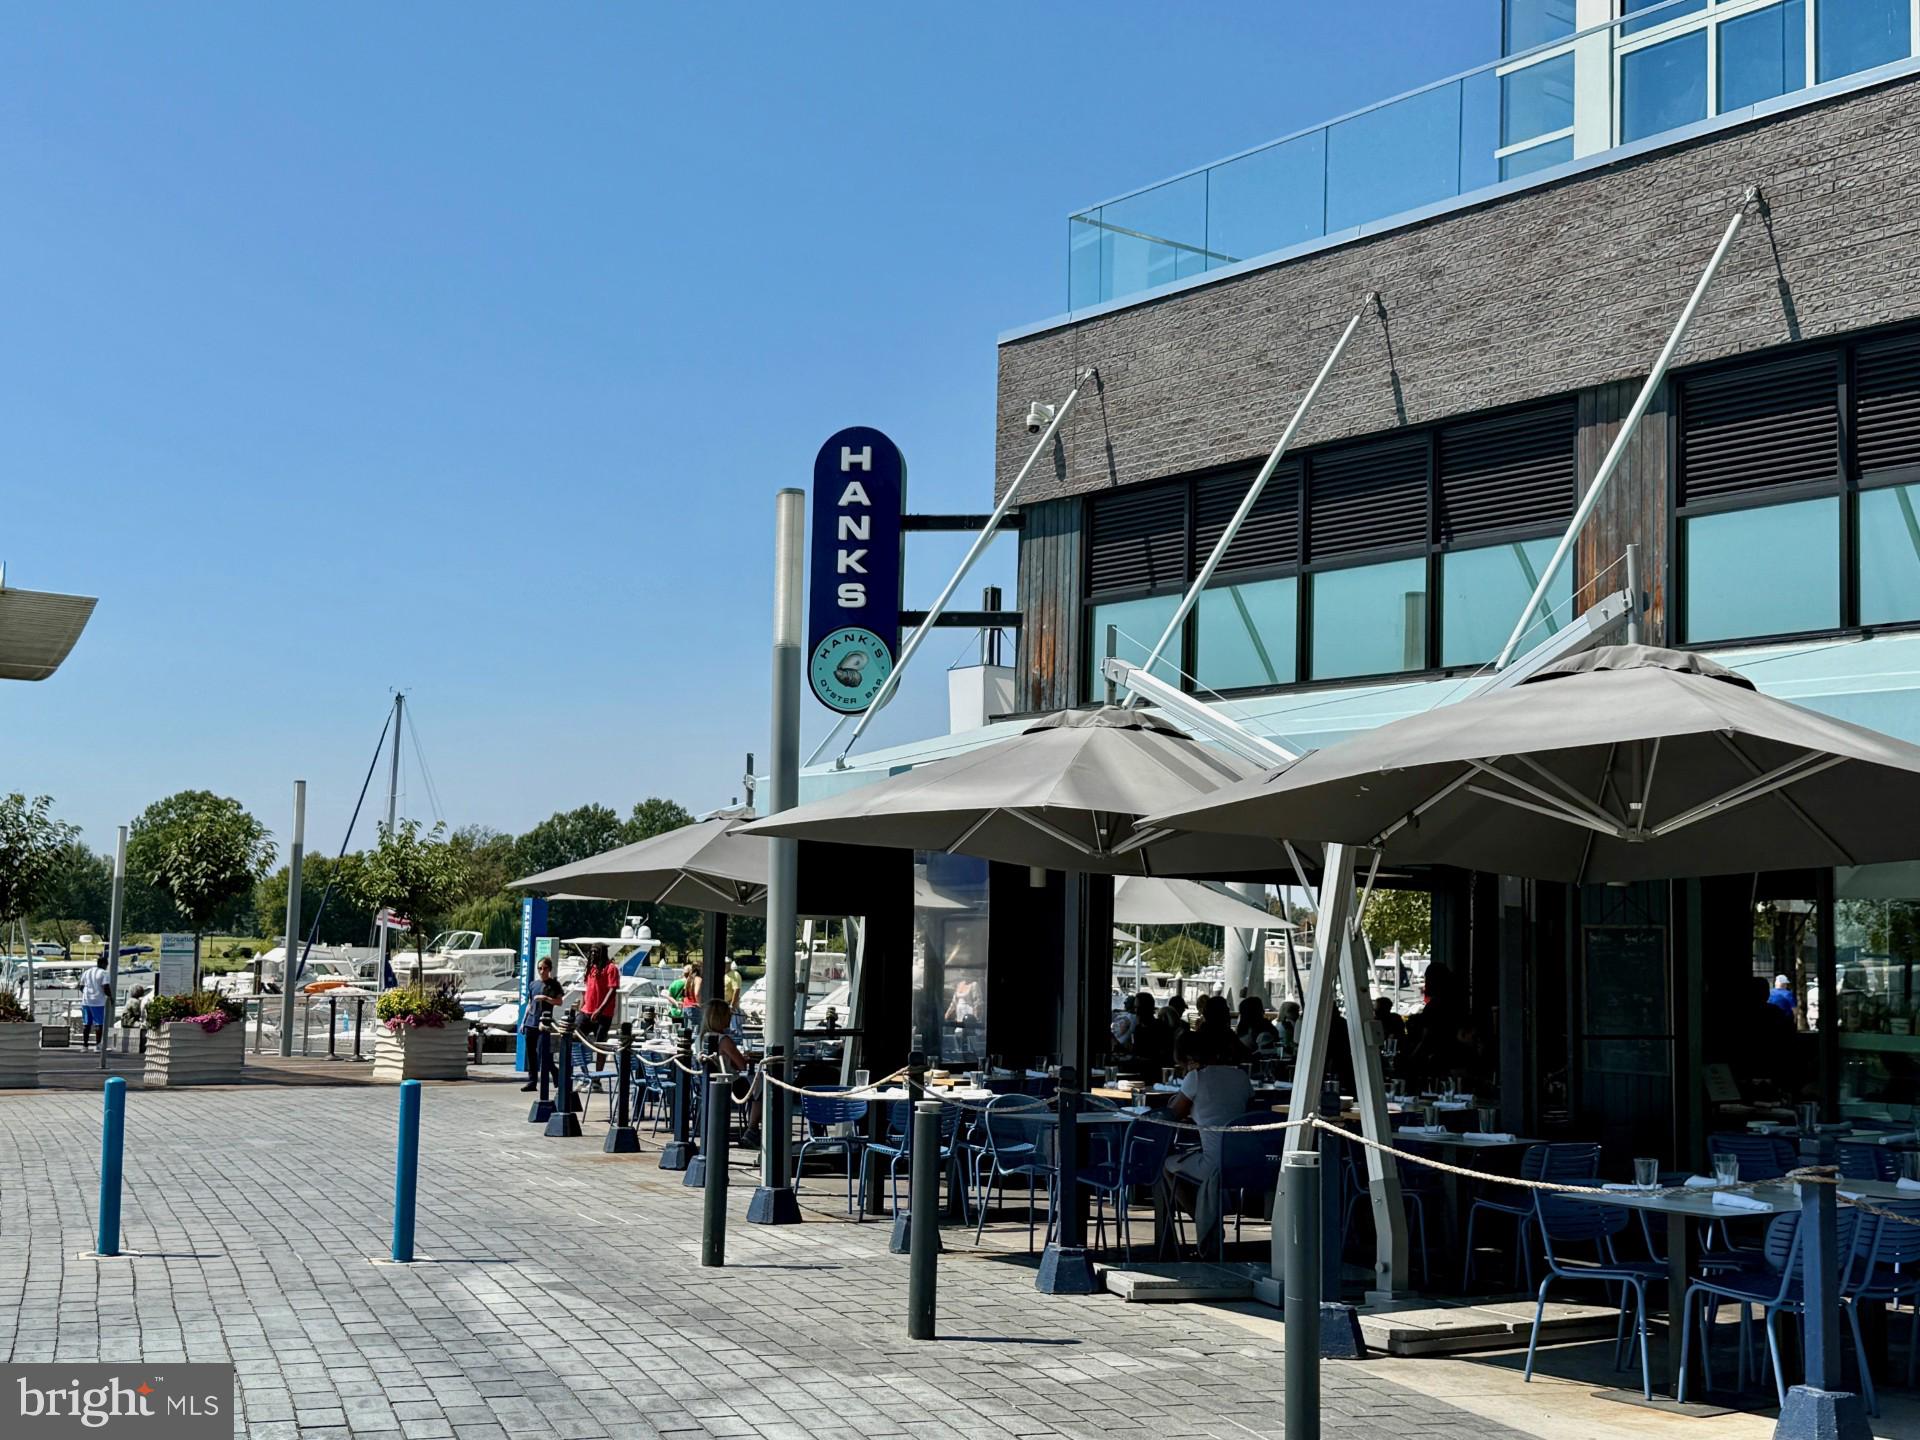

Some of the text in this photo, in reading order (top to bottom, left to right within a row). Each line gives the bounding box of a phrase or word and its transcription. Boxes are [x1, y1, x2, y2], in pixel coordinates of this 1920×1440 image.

[837, 446, 871, 608] HANKS
[820, 634, 883, 659] HANK'S
[821, 678, 883, 704] OYSTER BAR
